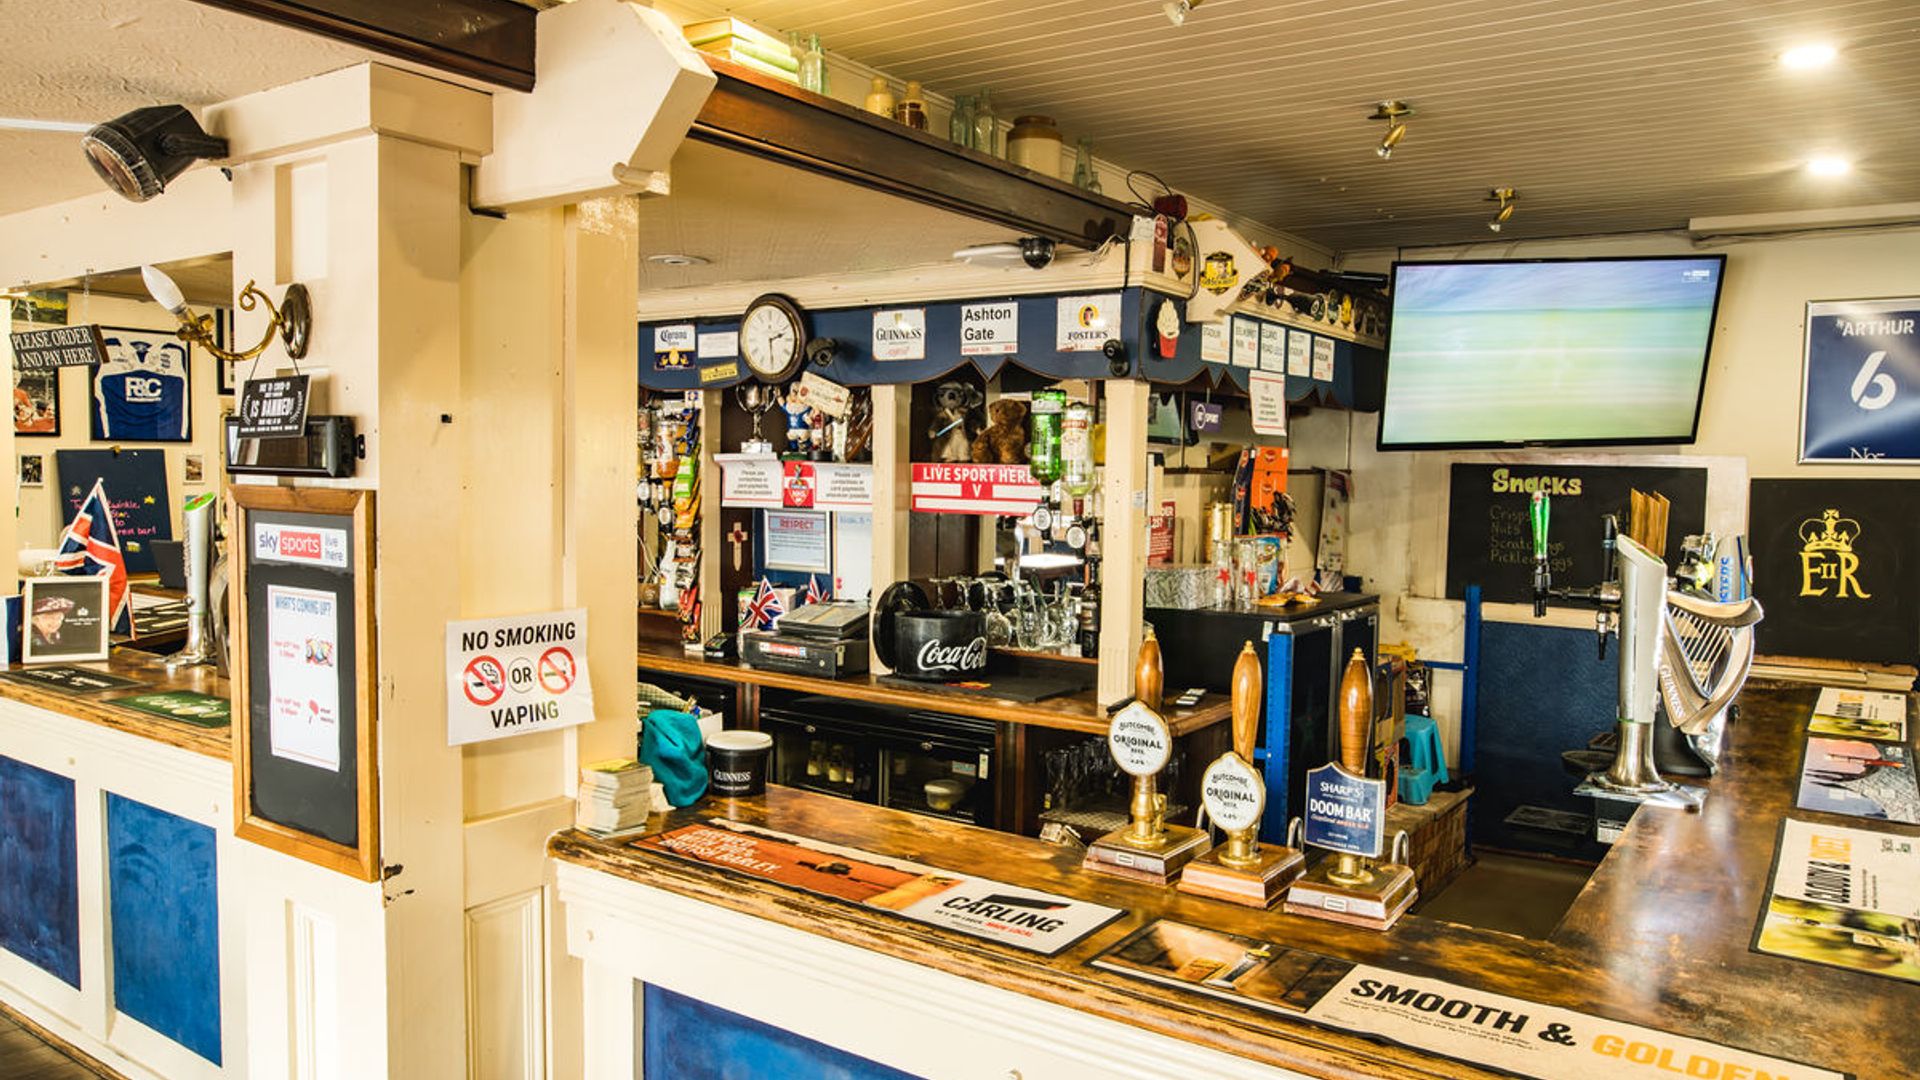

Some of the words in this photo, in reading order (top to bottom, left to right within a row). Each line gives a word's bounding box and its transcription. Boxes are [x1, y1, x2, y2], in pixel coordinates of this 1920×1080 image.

[964, 307, 1011, 321] Ashton
[12, 331, 52, 350] PLEASE
[51, 327, 92, 346] ORDER
[660, 329, 687, 342] Corona
[876, 327, 922, 341] GUINNESS
[964, 327, 994, 340] Gate
[1068, 329, 1108, 341] FOSTER'S
[20, 351, 43, 368] AND
[42, 349, 63, 366] PAY
[62, 347, 96, 365] HERE
[1851, 350, 1896, 410] 6
[923, 467, 951, 481] LIVE
[953, 467, 996, 483] SPORT
[999, 469, 1033, 483] HERE
[1492, 468, 1582, 496] Snacks
[972, 484, 982, 498] V
[780, 518, 814, 530] RESPECT
[259, 532, 278, 553] sky
[281, 533, 320, 554] sports
[325, 536, 338, 548] live
[325, 549, 343, 562] here
[462, 630, 488, 652] NO
[494, 622, 576, 648] SMOKING
[511, 667, 532, 685] OR
[1660, 663, 1685, 718] GUINNESS
[491, 701, 559, 728] VAPING
[1113, 734, 1163, 750] ORIGINAL
[714, 769, 752, 783] GUINNESS
[1206, 787, 1256, 803] ORIGINAL
[1320, 781, 1361, 798] SHARP'S
[1310, 798, 1344, 818] DOOM
[1345, 805, 1371, 823] BAR
[942, 896, 1064, 933] CARLING
[1351, 979, 1530, 1034] SMOOTH
[1538, 1023, 1576, 1046] &
